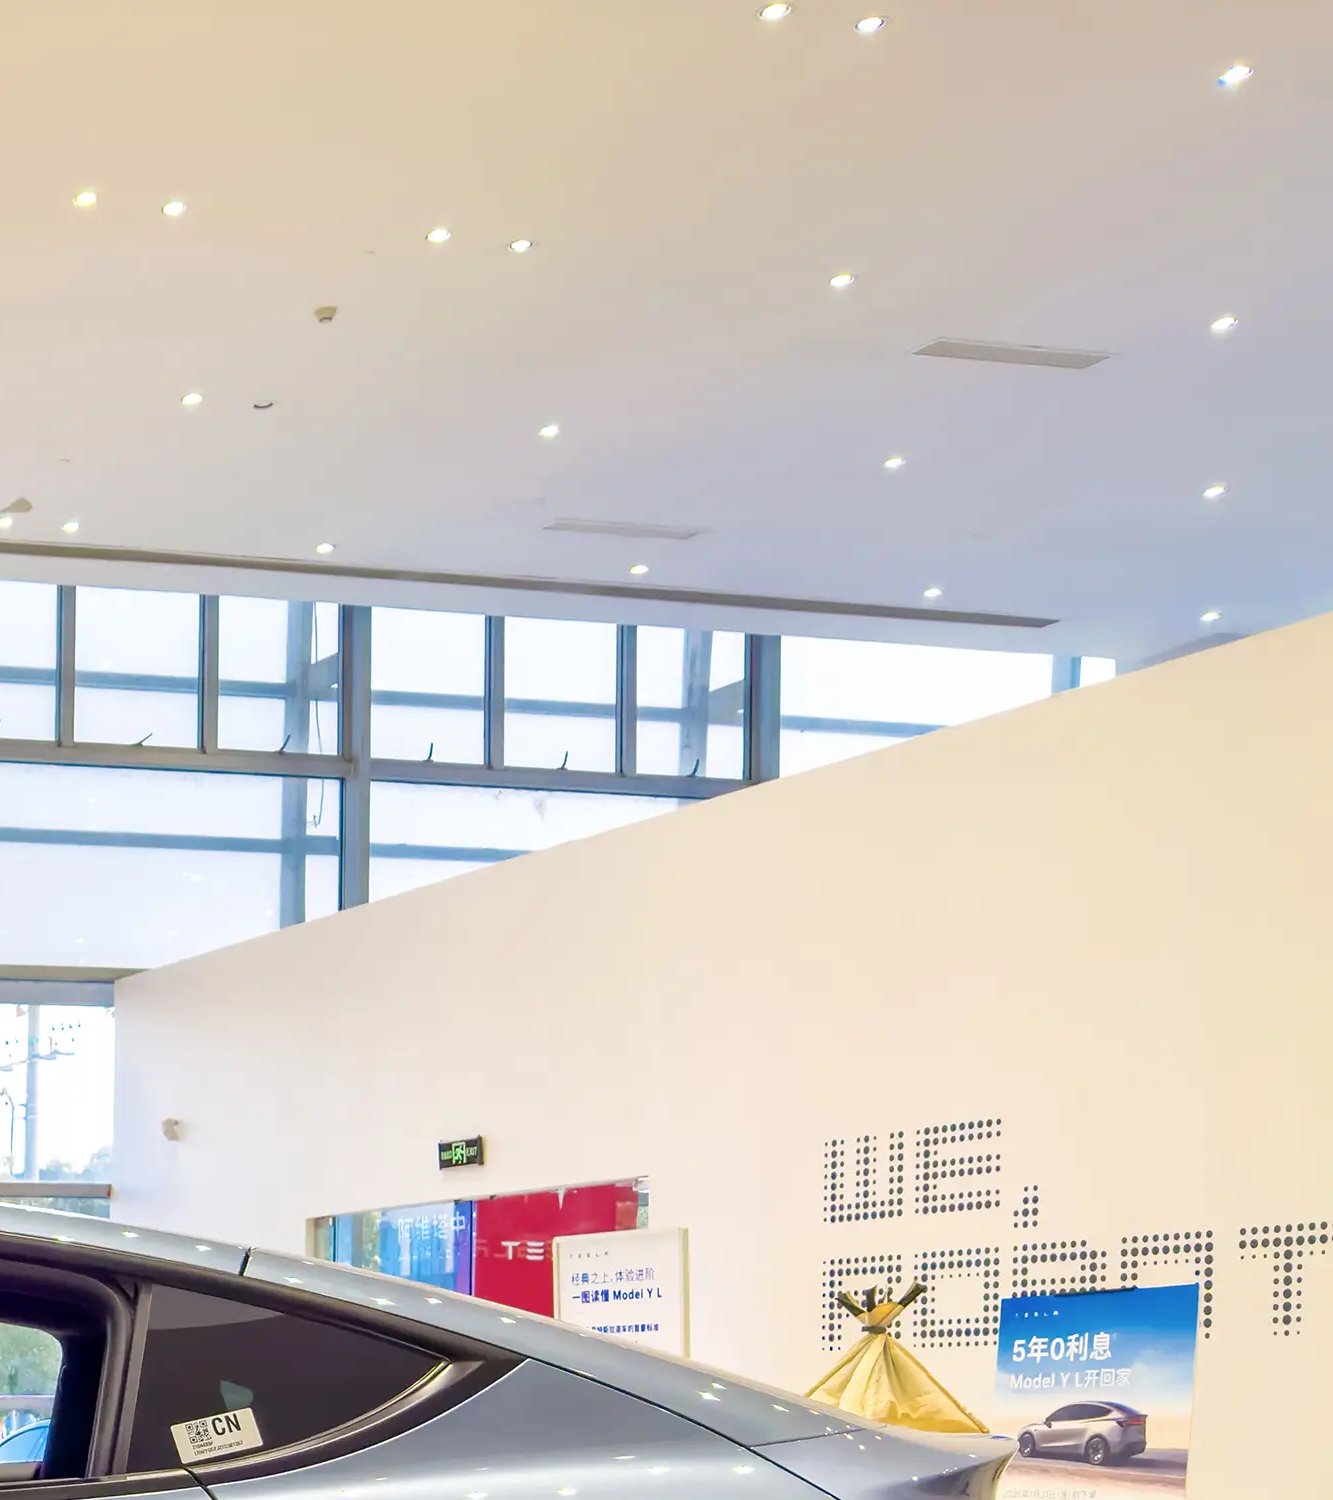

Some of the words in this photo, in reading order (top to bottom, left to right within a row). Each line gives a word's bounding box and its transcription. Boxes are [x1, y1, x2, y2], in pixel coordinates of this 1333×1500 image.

[466, 1146, 478, 1157] EXIT
[501, 1241, 546, 1261] TE
[613, 1288, 644, 1301] Model
[646, 1287, 654, 1299] Y
[657, 1286, 663, 1298] L
[1010, 1372, 1056, 1389] Model
[1060, 1372, 1071, 1388] Y
[211, 1413, 242, 1436] CN
